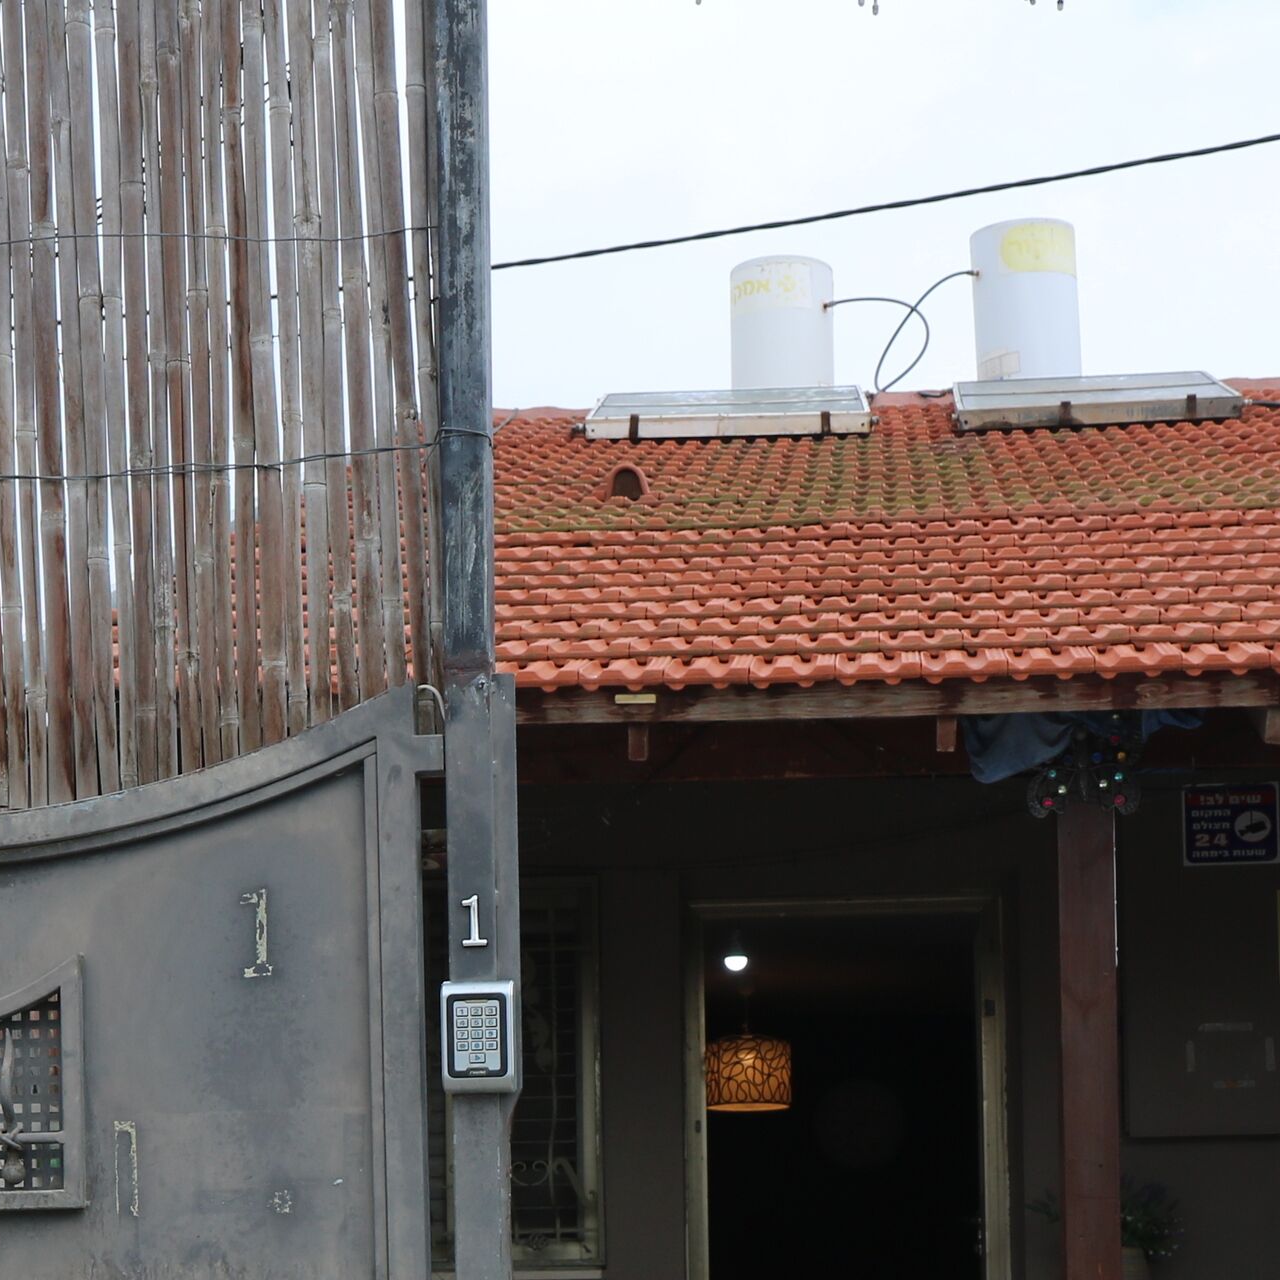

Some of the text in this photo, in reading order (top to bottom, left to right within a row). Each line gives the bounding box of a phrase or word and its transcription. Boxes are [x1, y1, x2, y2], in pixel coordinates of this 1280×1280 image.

[1199, 793, 1262, 806] שים לב!
[1191, 808, 1231, 818] המקום
[1192, 821, 1231, 830] מצולם
[1194, 832, 1229, 848] 24
[1191, 848, 1266, 858] שעות ביממה
[461, 894, 489, 948] 1
